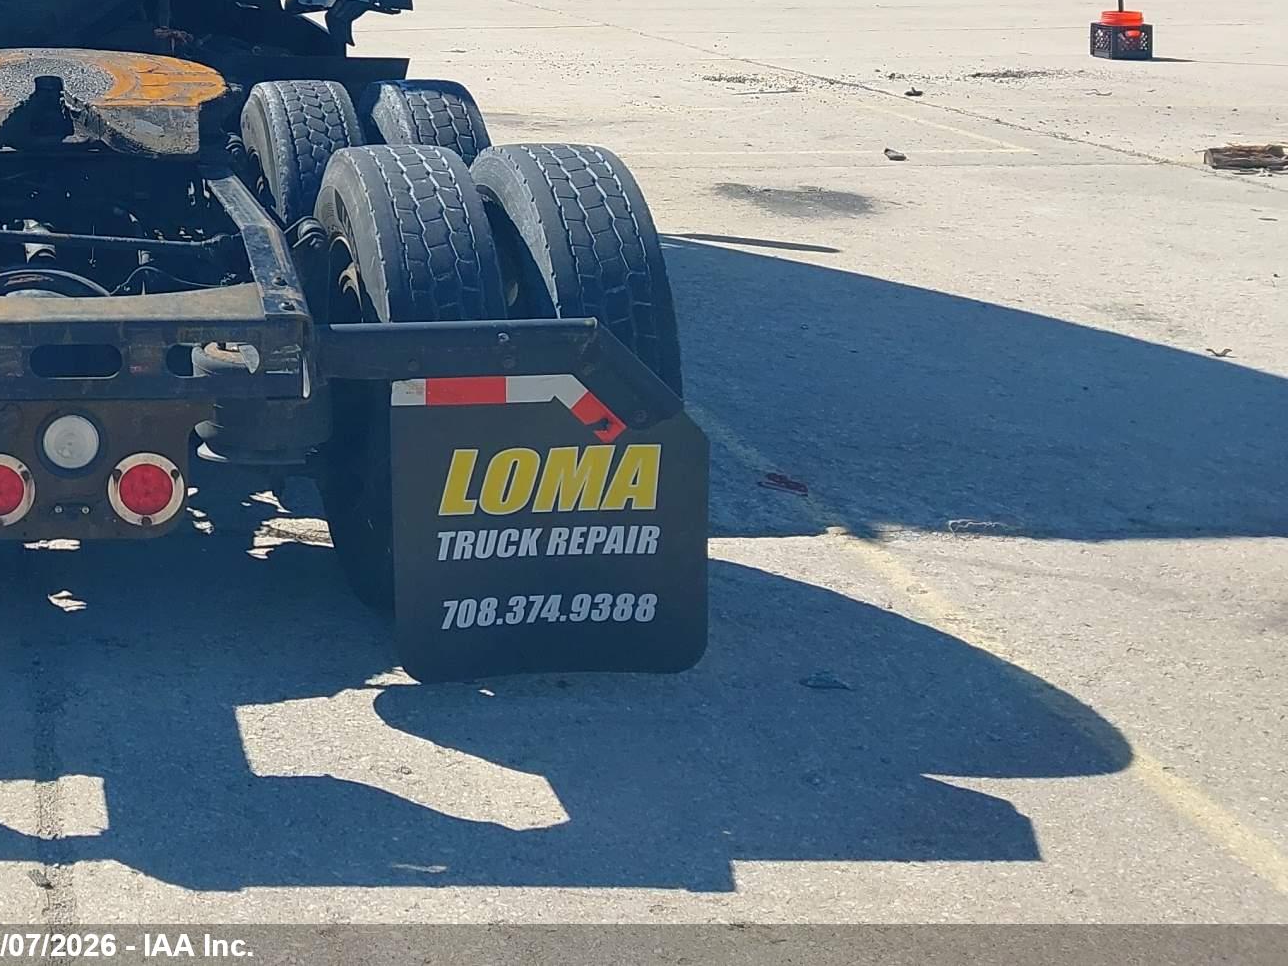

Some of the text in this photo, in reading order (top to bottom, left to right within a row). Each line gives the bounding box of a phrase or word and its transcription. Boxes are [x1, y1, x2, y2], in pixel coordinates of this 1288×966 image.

[438, 444, 661, 516] LOMA
[437, 525, 661, 561] TRUCK REPAIR
[441, 593, 658, 630] 708.374.9388
